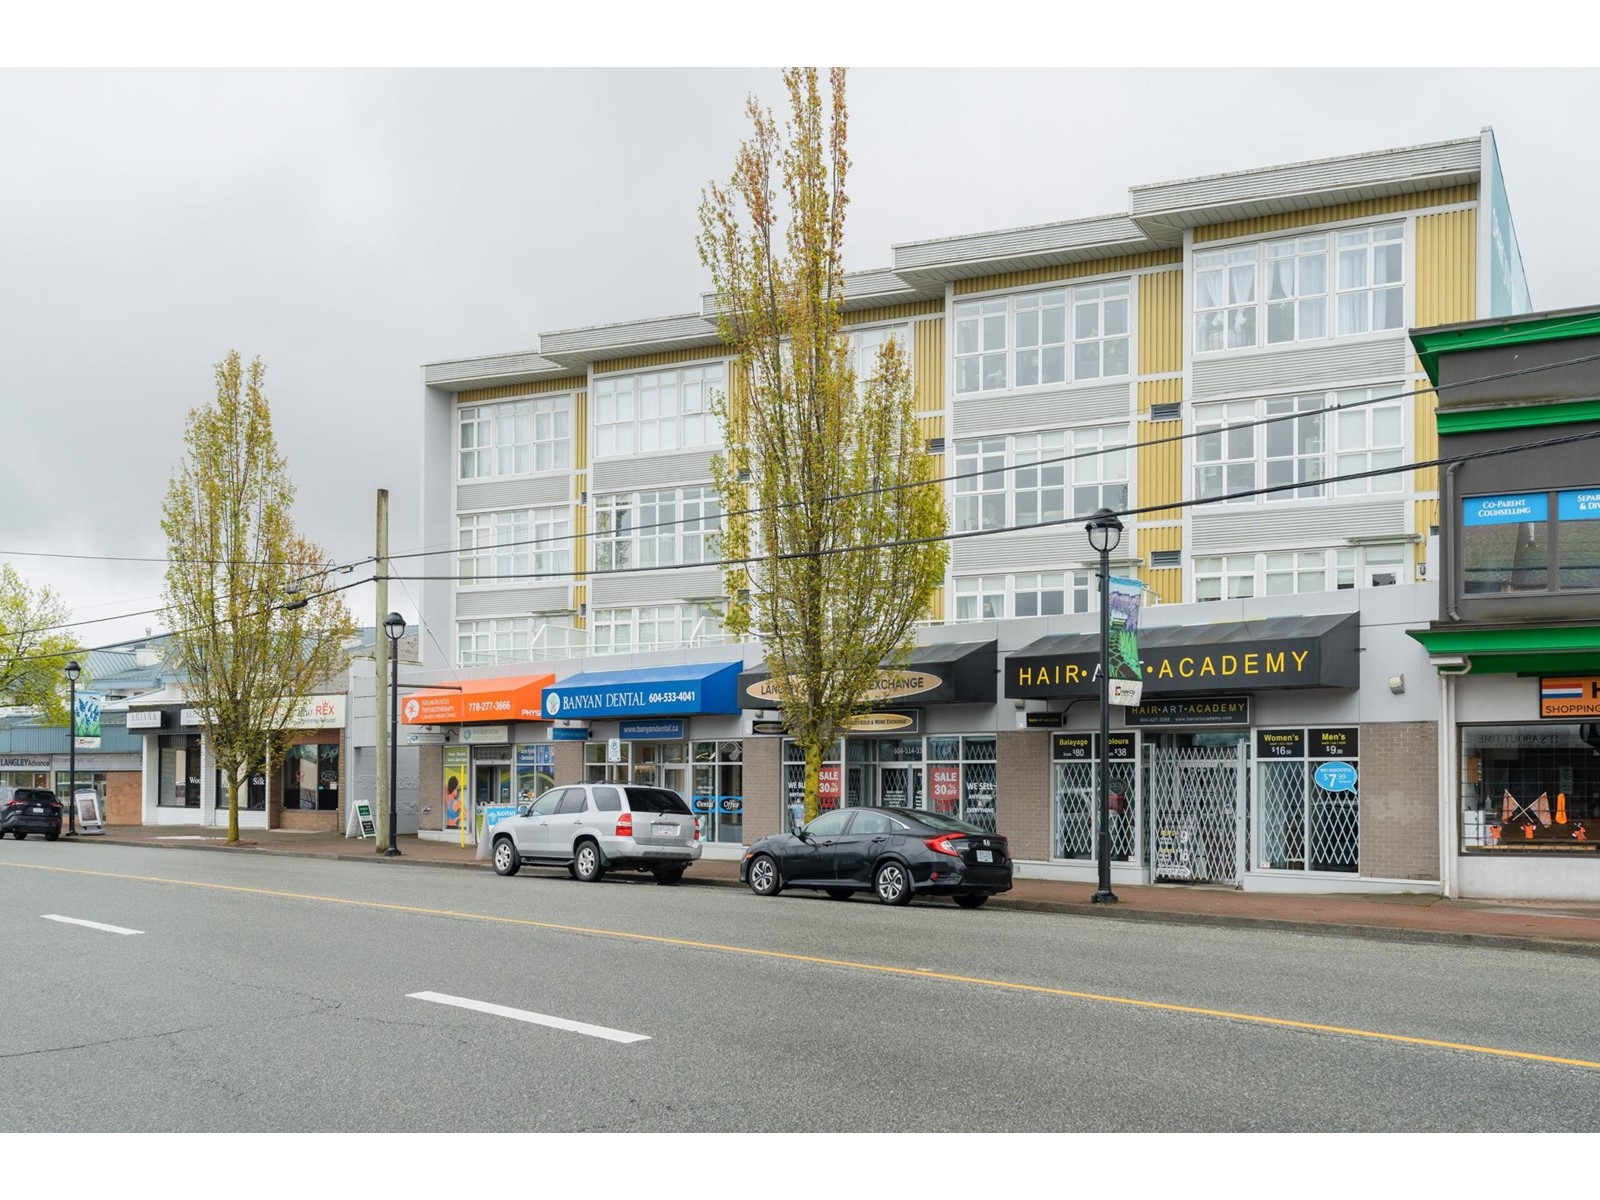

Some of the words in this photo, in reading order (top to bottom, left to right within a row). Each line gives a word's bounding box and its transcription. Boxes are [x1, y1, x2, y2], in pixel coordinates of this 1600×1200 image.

[1478, 507, 1531, 517] COUNSELLING
[1019, 664, 1079, 686] HAIR
[1158, 650, 1309, 679] ACADEMY
[563, 695, 602, 710] BANYAN
[605, 691, 646, 707] DENTAL
[648, 691, 696, 703] 604-533-4041
[468, 700, 511, 712] 778-277-3666
[1131, 705, 1158, 715] HAIR
[1162, 704, 1184, 714] ART
[1188, 702, 1245, 713] ACADEMY
[623, 724, 679, 734] www.banyandental.ca
[1263, 734, 1299, 742] Women's
[1321, 732, 1346, 741] Men's
[1059, 739, 1088, 747] Balayage
[1072, 748, 1085, 757] $80
[1114, 748, 1127, 757] $38
[0, 758, 28, 767] LANGLEY
[819, 771, 839, 780] SALE
[934, 772, 957, 782] SALE
[787, 781, 797, 789] WE
[819, 783, 830, 793] 30
[934, 784, 947, 795] 30
[966, 782, 977, 791] WE
[979, 781, 994, 791] SELL
[723, 799, 740, 810] Office
